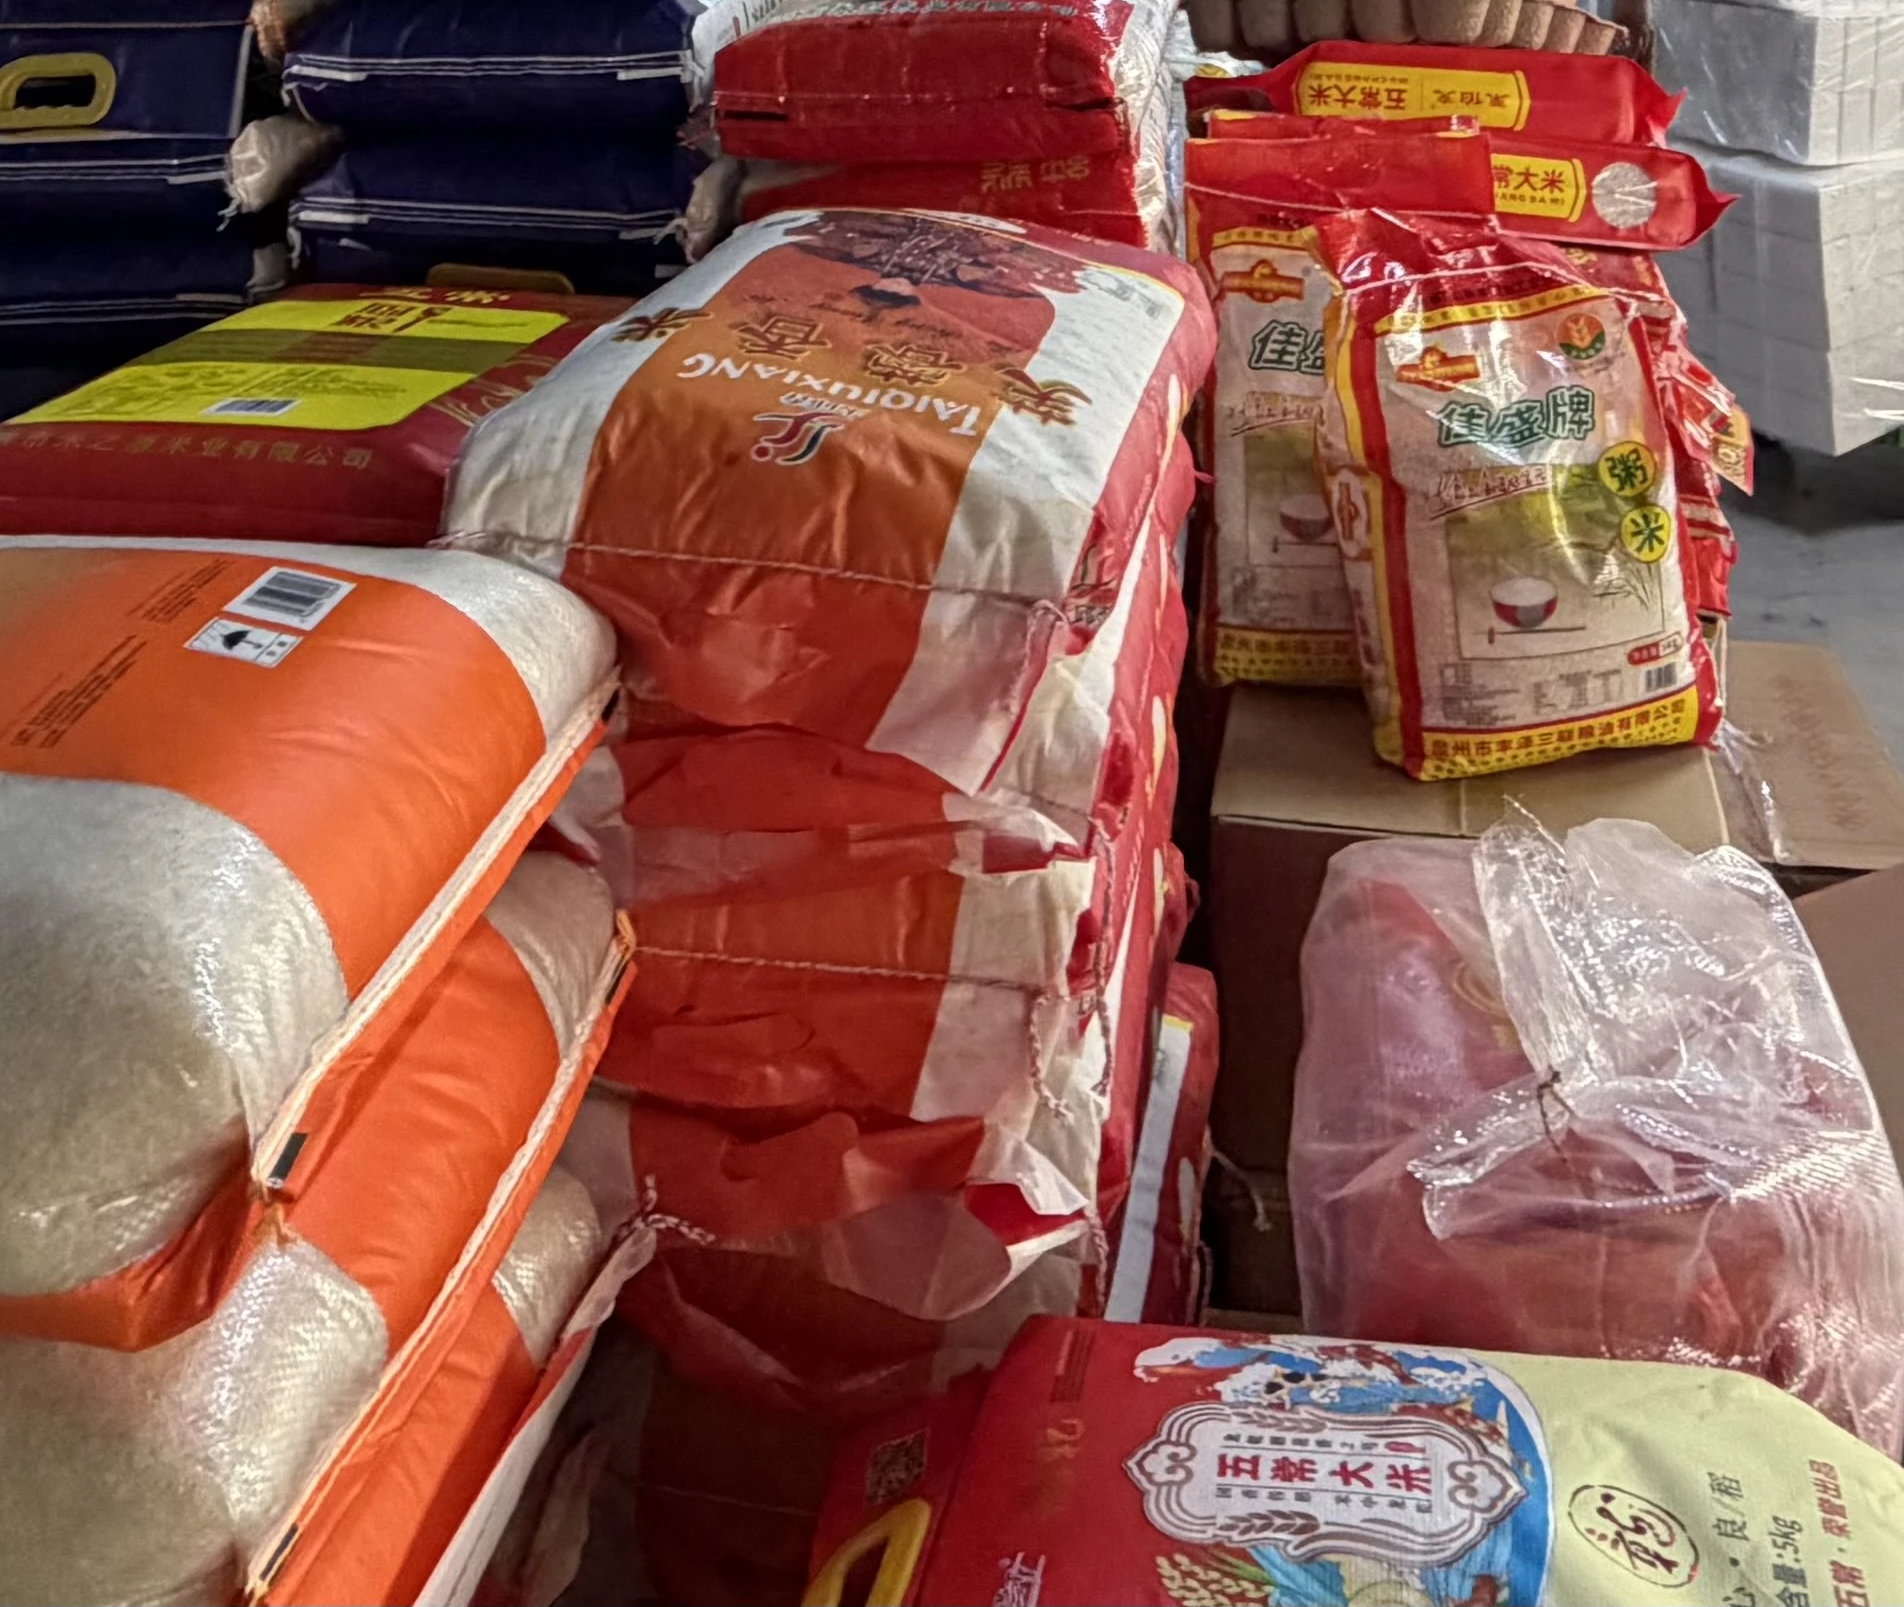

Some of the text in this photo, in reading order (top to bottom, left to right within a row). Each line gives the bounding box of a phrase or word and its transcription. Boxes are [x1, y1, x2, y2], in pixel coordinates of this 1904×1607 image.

[1307, 84, 1408, 111] 五常大米
[1436, 386, 1595, 450] 佳盛牌
[1628, 514, 1668, 554] 米
[1214, 1448, 1434, 1502] 五常大米
